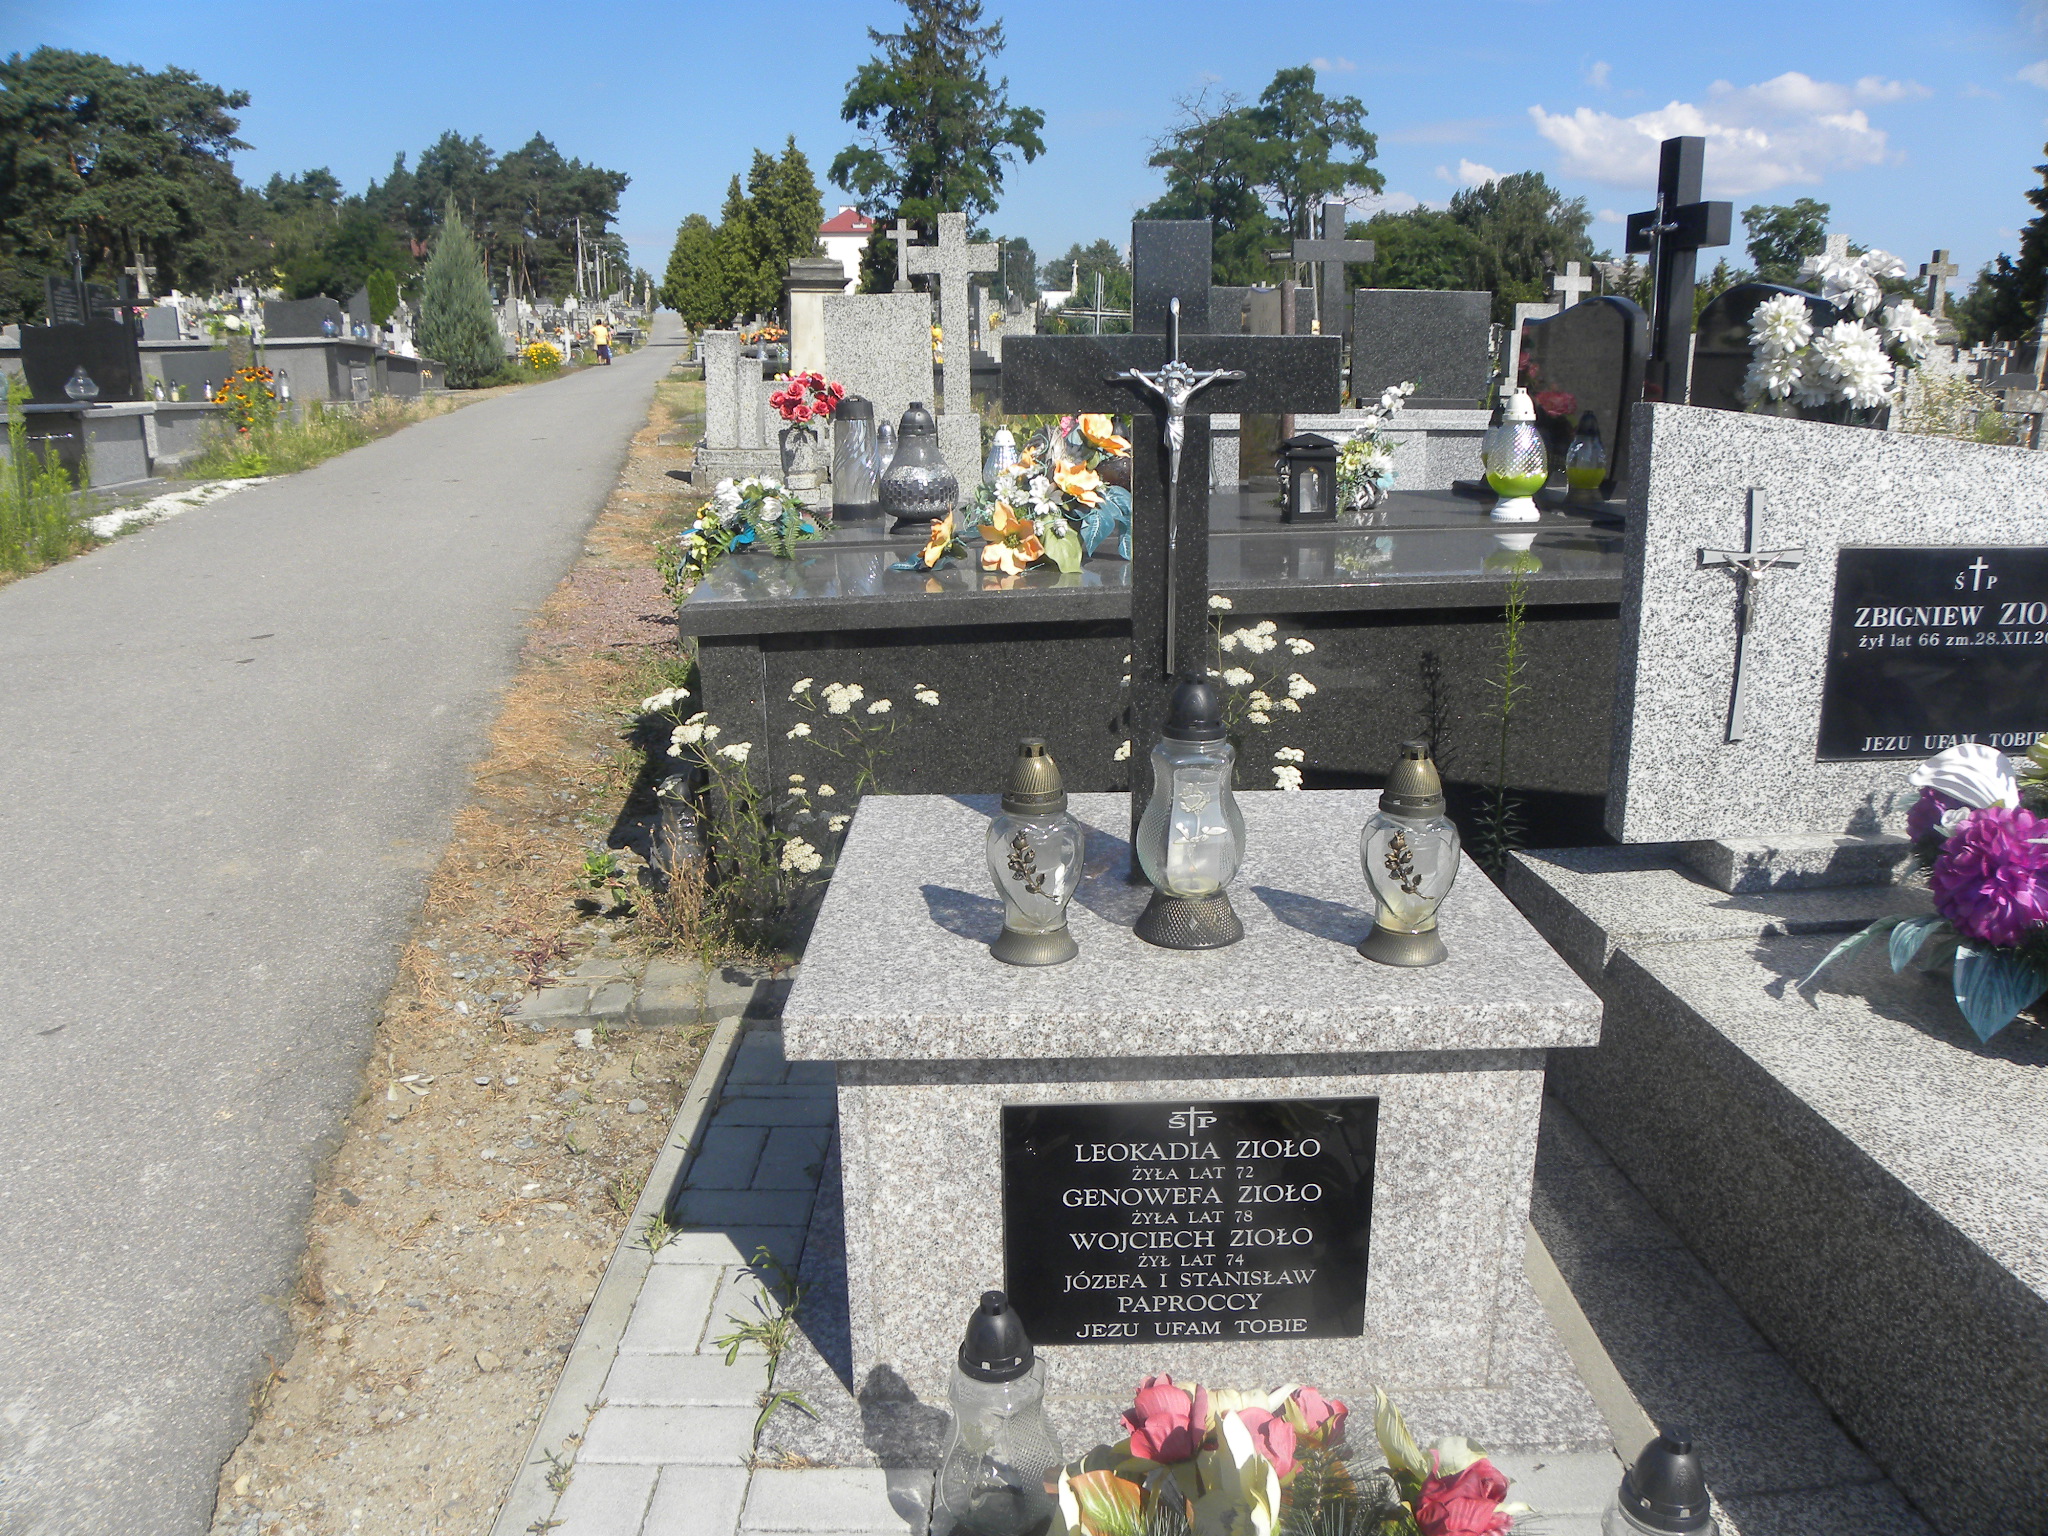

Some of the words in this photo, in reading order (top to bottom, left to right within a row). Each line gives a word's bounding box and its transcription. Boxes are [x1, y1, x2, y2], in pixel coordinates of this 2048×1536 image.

[1854, 605, 1984, 627] ZBIGNIEW
[1998, 602, 2048, 626] ZIO
[1859, 633, 1884, 650] żył
[1890, 633, 1912, 647] lat
[1918, 633, 1940, 646] 66
[1862, 735, 1911, 752] JEZU
[1075, 1142, 1221, 1162] LEOKADIA
[1236, 1139, 1321, 1159] ZIOŁO
[1132, 1166, 1179, 1181] ŻYŁA
[1189, 1167, 1226, 1180] LAT
[1236, 1166, 1254, 1179] 72
[1062, 1187, 1223, 1208] GENOWEFA
[1238, 1183, 1322, 1203] ZIOŁO
[1131, 1209, 1179, 1225] ŻYŁA
[1189, 1211, 1224, 1224] LAT
[1235, 1210, 1253, 1223] 78
[1069, 1231, 1215, 1253] WOJCIECH
[1230, 1228, 1313, 1248] ZIOŁO
[1138, 1253, 1171, 1268] ŻYŁ
[1181, 1254, 1216, 1267] LAT
[1226, 1253, 1244, 1266] 74
[1064, 1271, 1146, 1292] JÓZEFA
[1159, 1273, 1168, 1288] I
[1180, 1269, 1317, 1288] STANISŁAW
[1118, 1292, 1263, 1313] PAPROCCY
[1076, 1323, 1139, 1338] JEZU
[1155, 1321, 1221, 1336] UFAM
[1235, 1319, 1308, 1333] TOBIE
